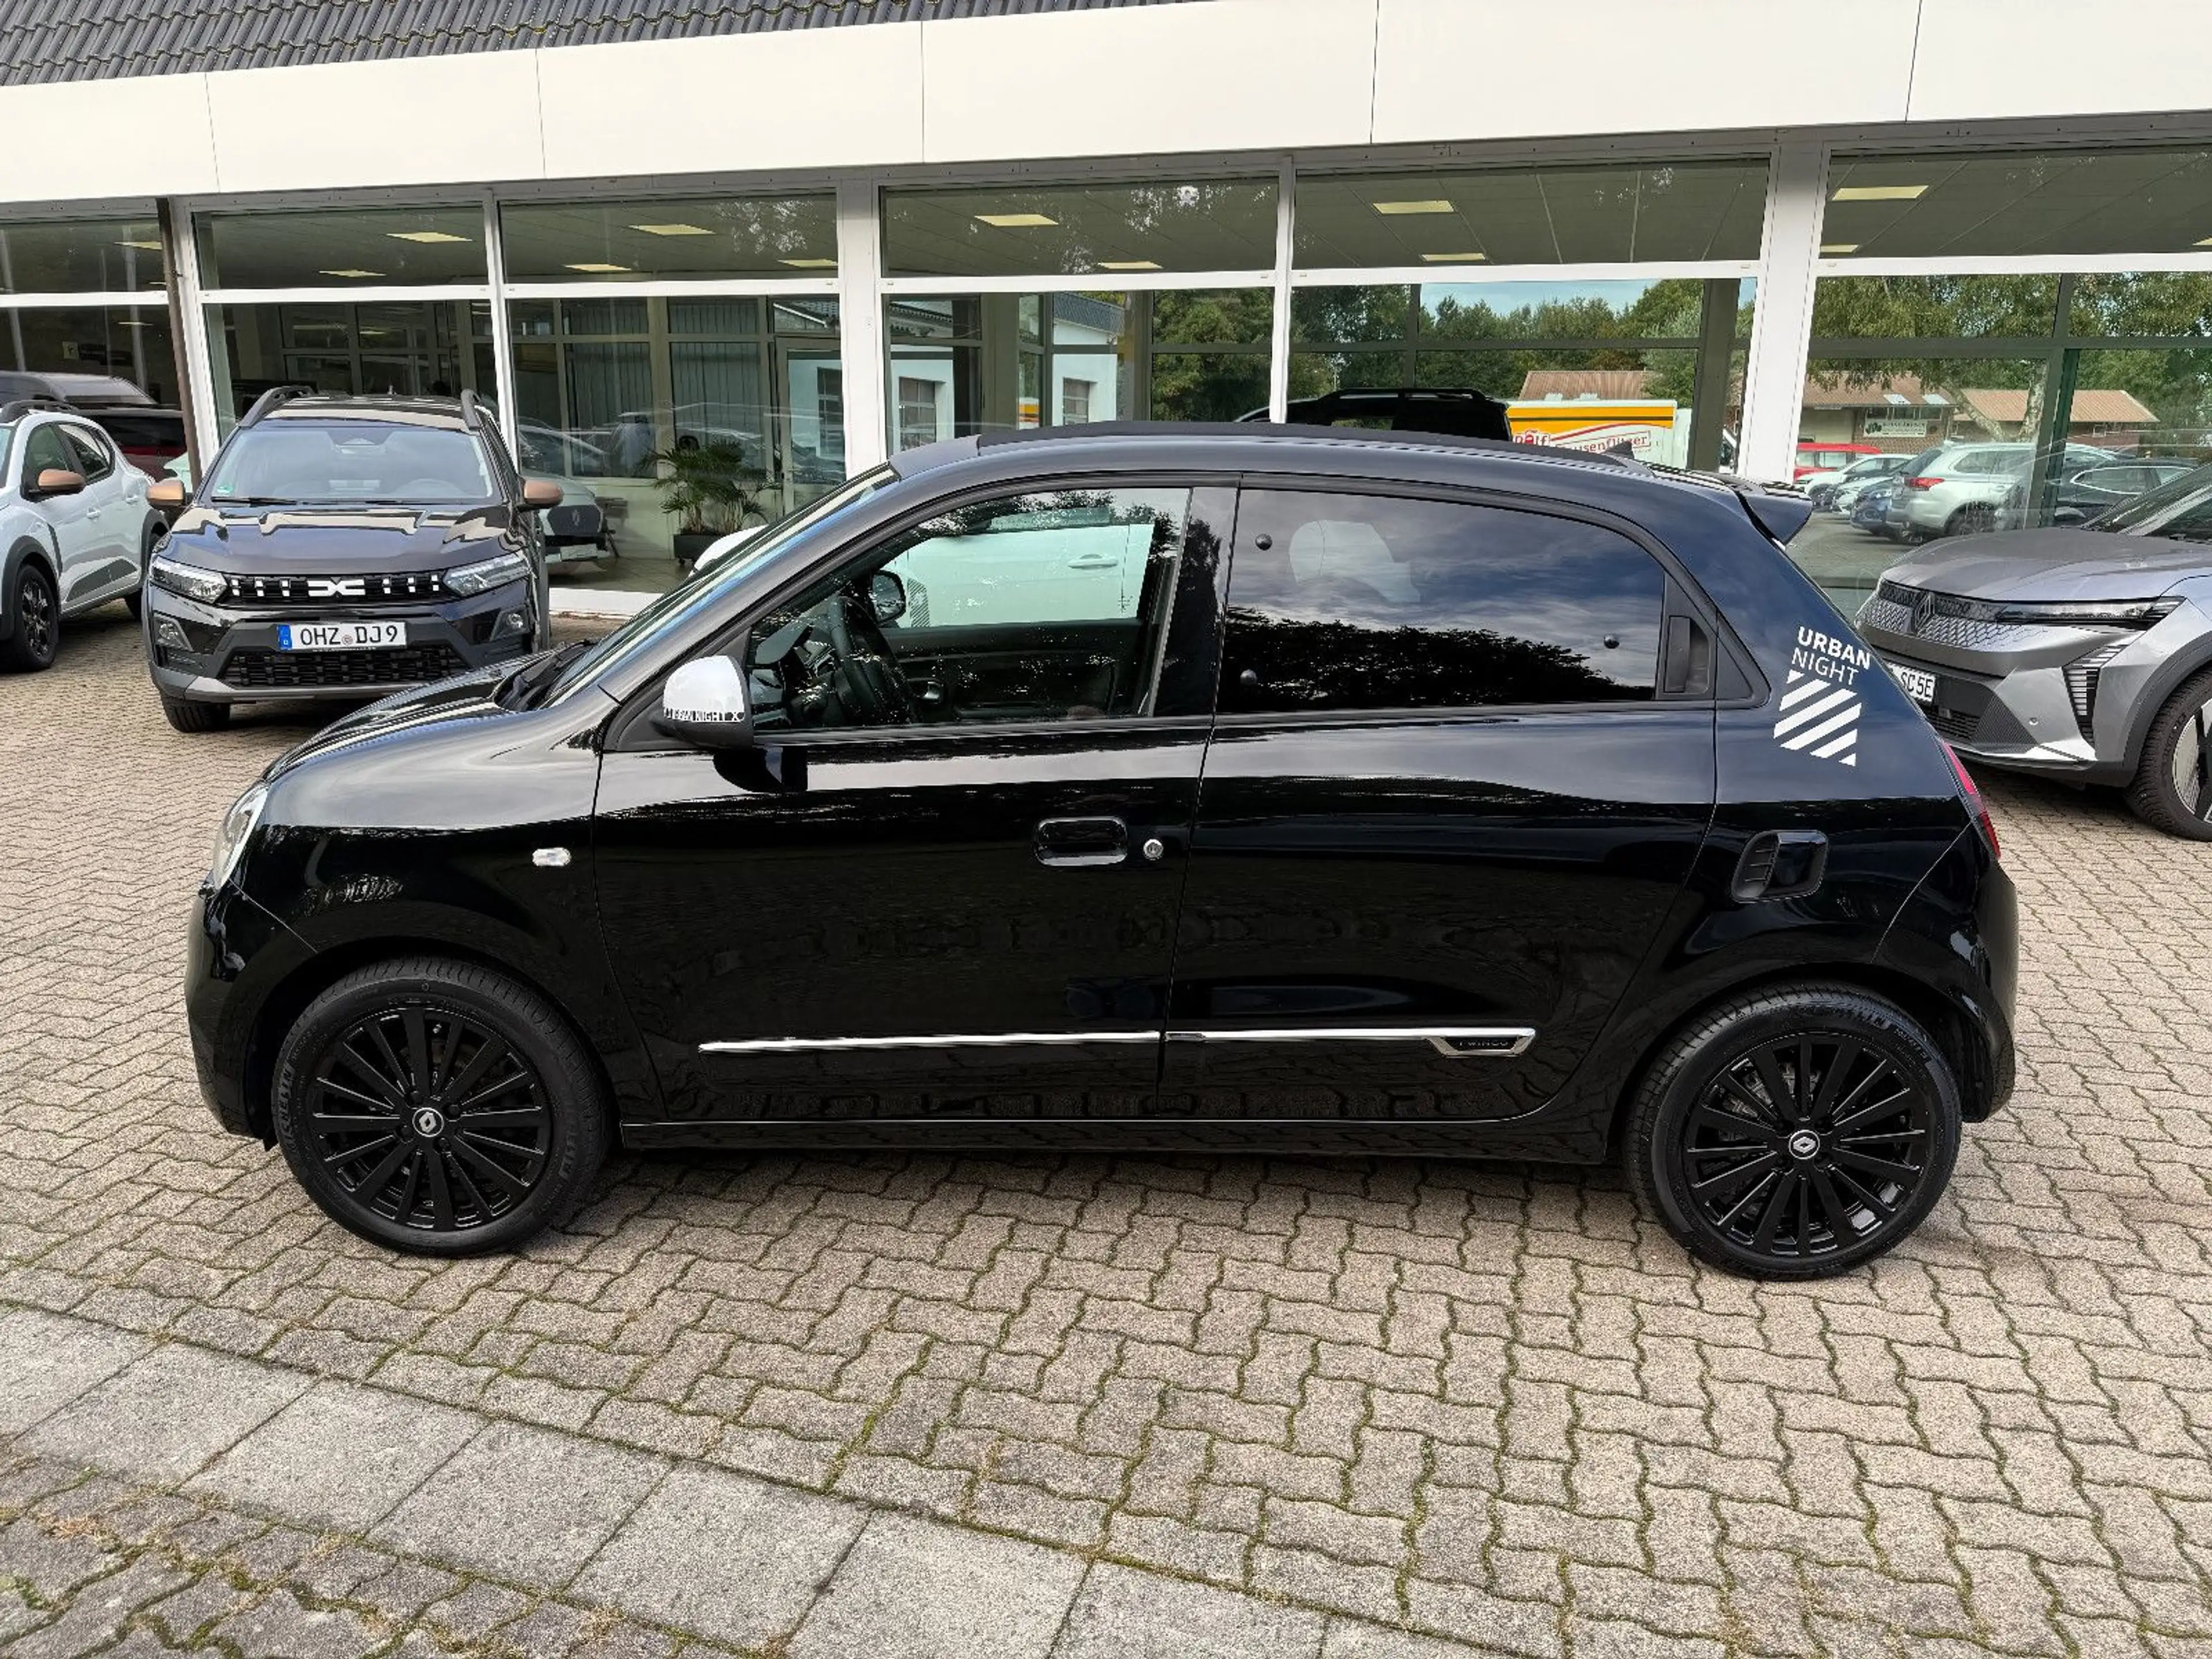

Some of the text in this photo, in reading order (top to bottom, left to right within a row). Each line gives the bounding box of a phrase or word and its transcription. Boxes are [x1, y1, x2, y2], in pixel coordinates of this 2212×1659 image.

[300, 627, 341, 646] OHZ
[1798, 626, 1871, 670] URBAN
[1791, 647, 1859, 685] NIGHT
[695, 710, 726, 721] NIGHT
